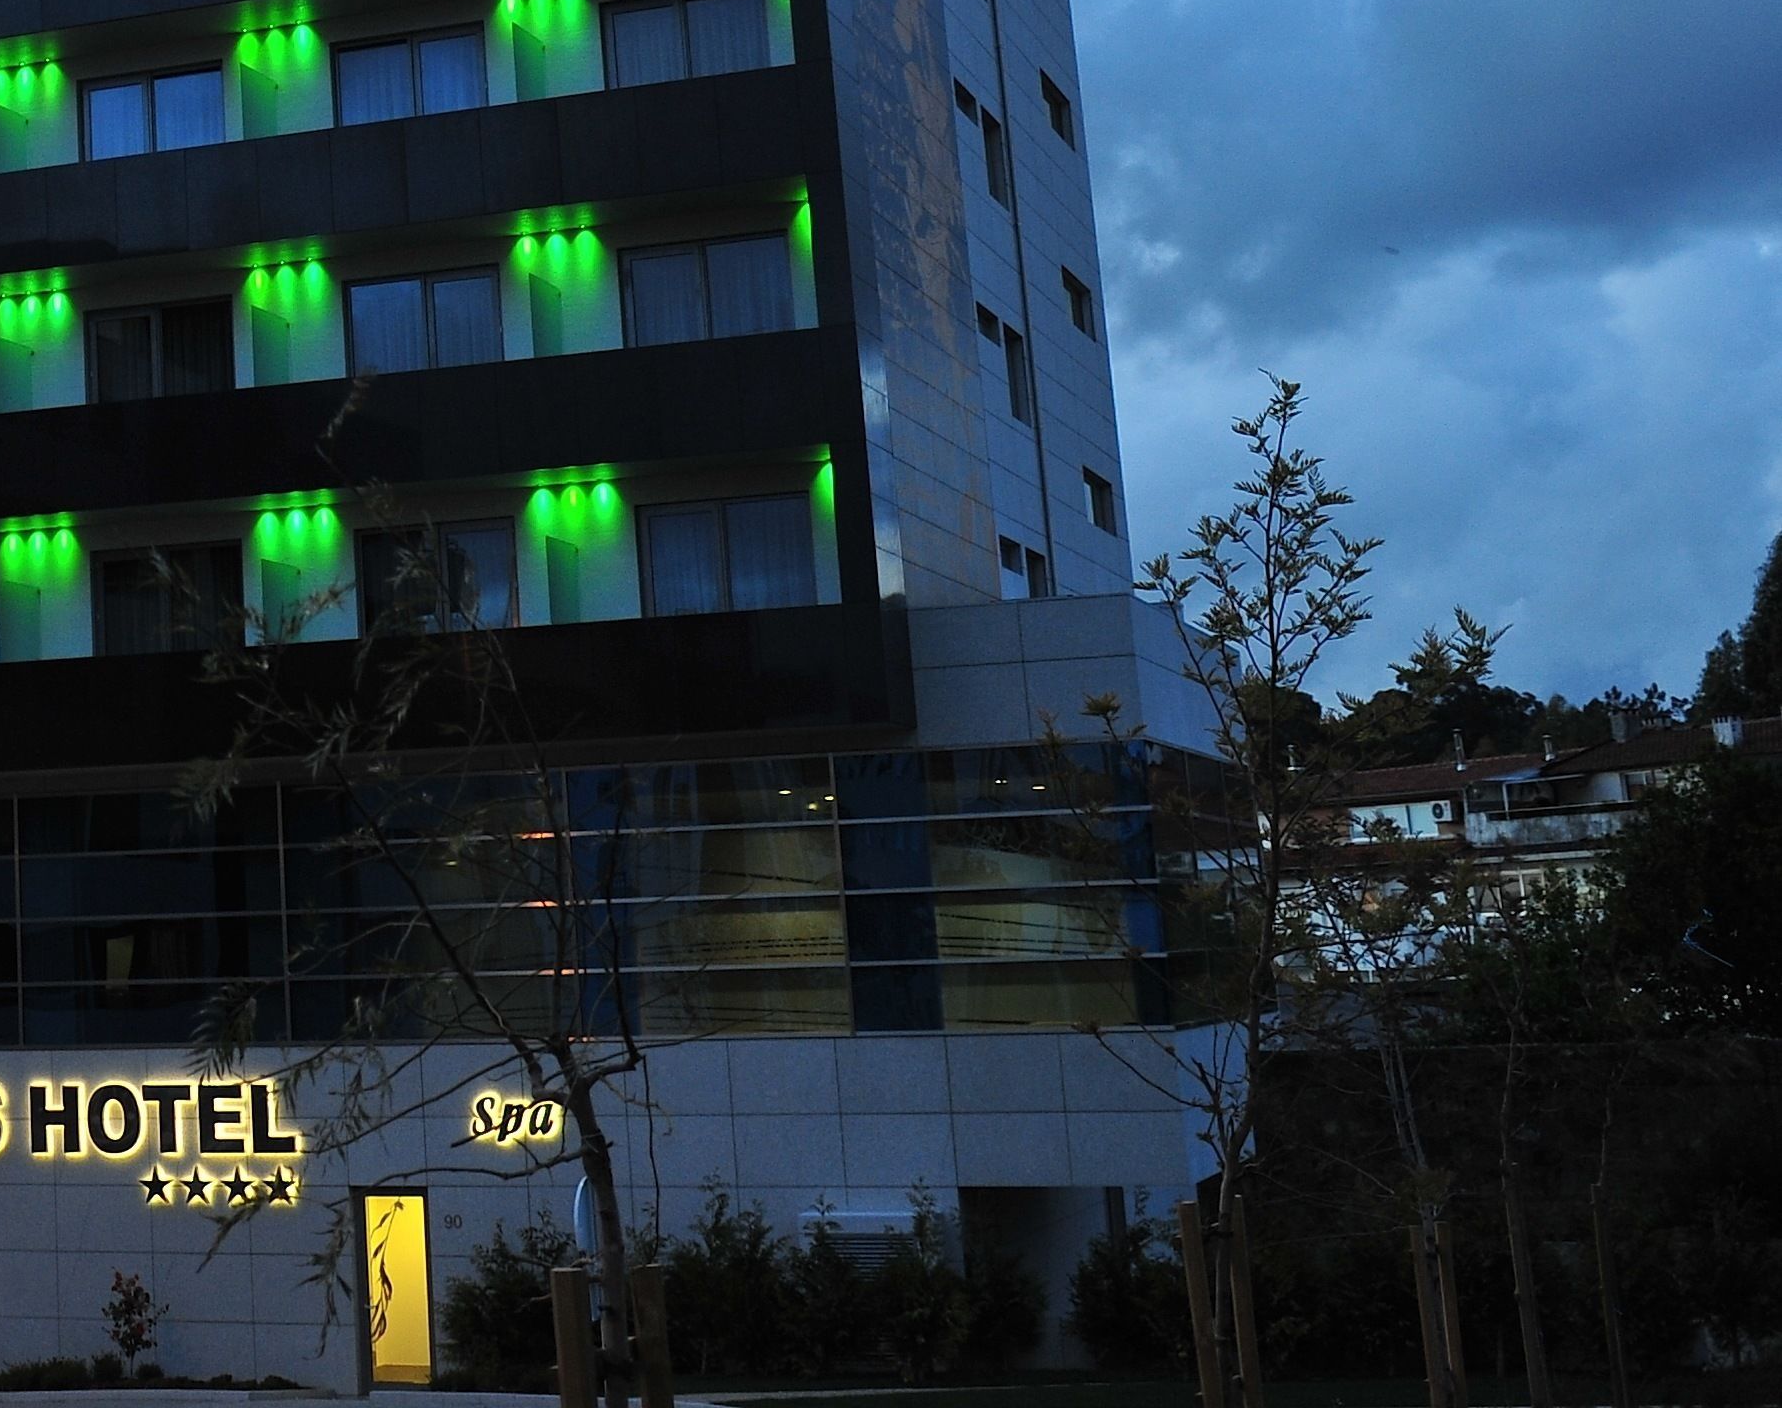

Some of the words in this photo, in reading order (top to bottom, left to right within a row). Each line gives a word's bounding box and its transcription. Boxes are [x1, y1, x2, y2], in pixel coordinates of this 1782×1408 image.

[29, 1084, 296, 1154] HOTEL
[472, 1097, 553, 1142] Spa
[444, 1214, 462, 1229] 90
